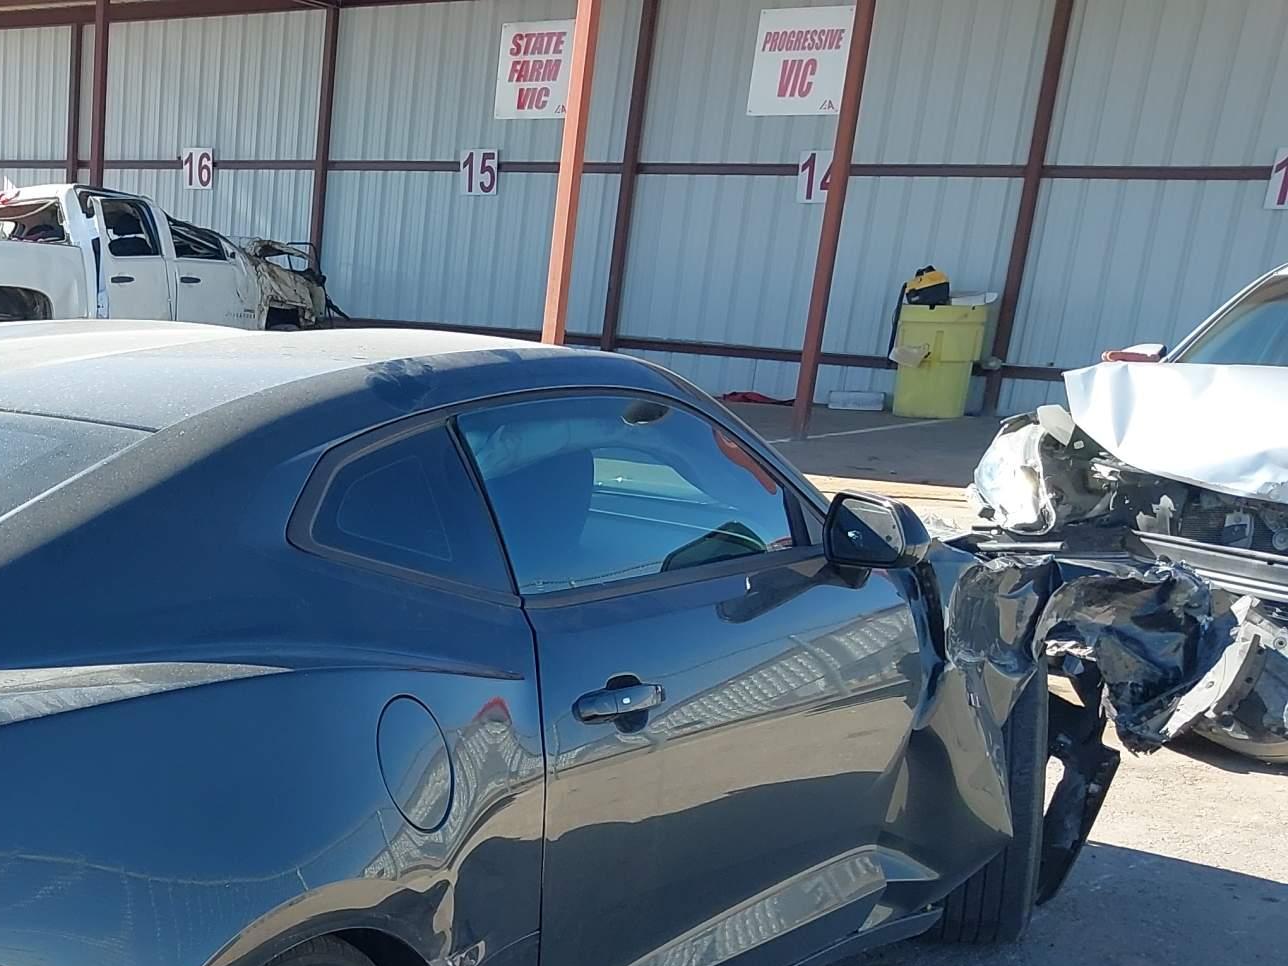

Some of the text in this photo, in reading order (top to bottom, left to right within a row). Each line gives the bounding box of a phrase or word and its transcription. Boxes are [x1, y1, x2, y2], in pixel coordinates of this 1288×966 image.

[509, 31, 567, 56] STATE
[761, 28, 846, 52] PROGRESSIVE
[507, 58, 562, 83] FARM
[776, 58, 817, 98] VIC
[516, 86, 550, 110] VIC
[183, 151, 212, 187] 16
[462, 151, 496, 193] 15
[1274, 156, 1288, 206] 1
